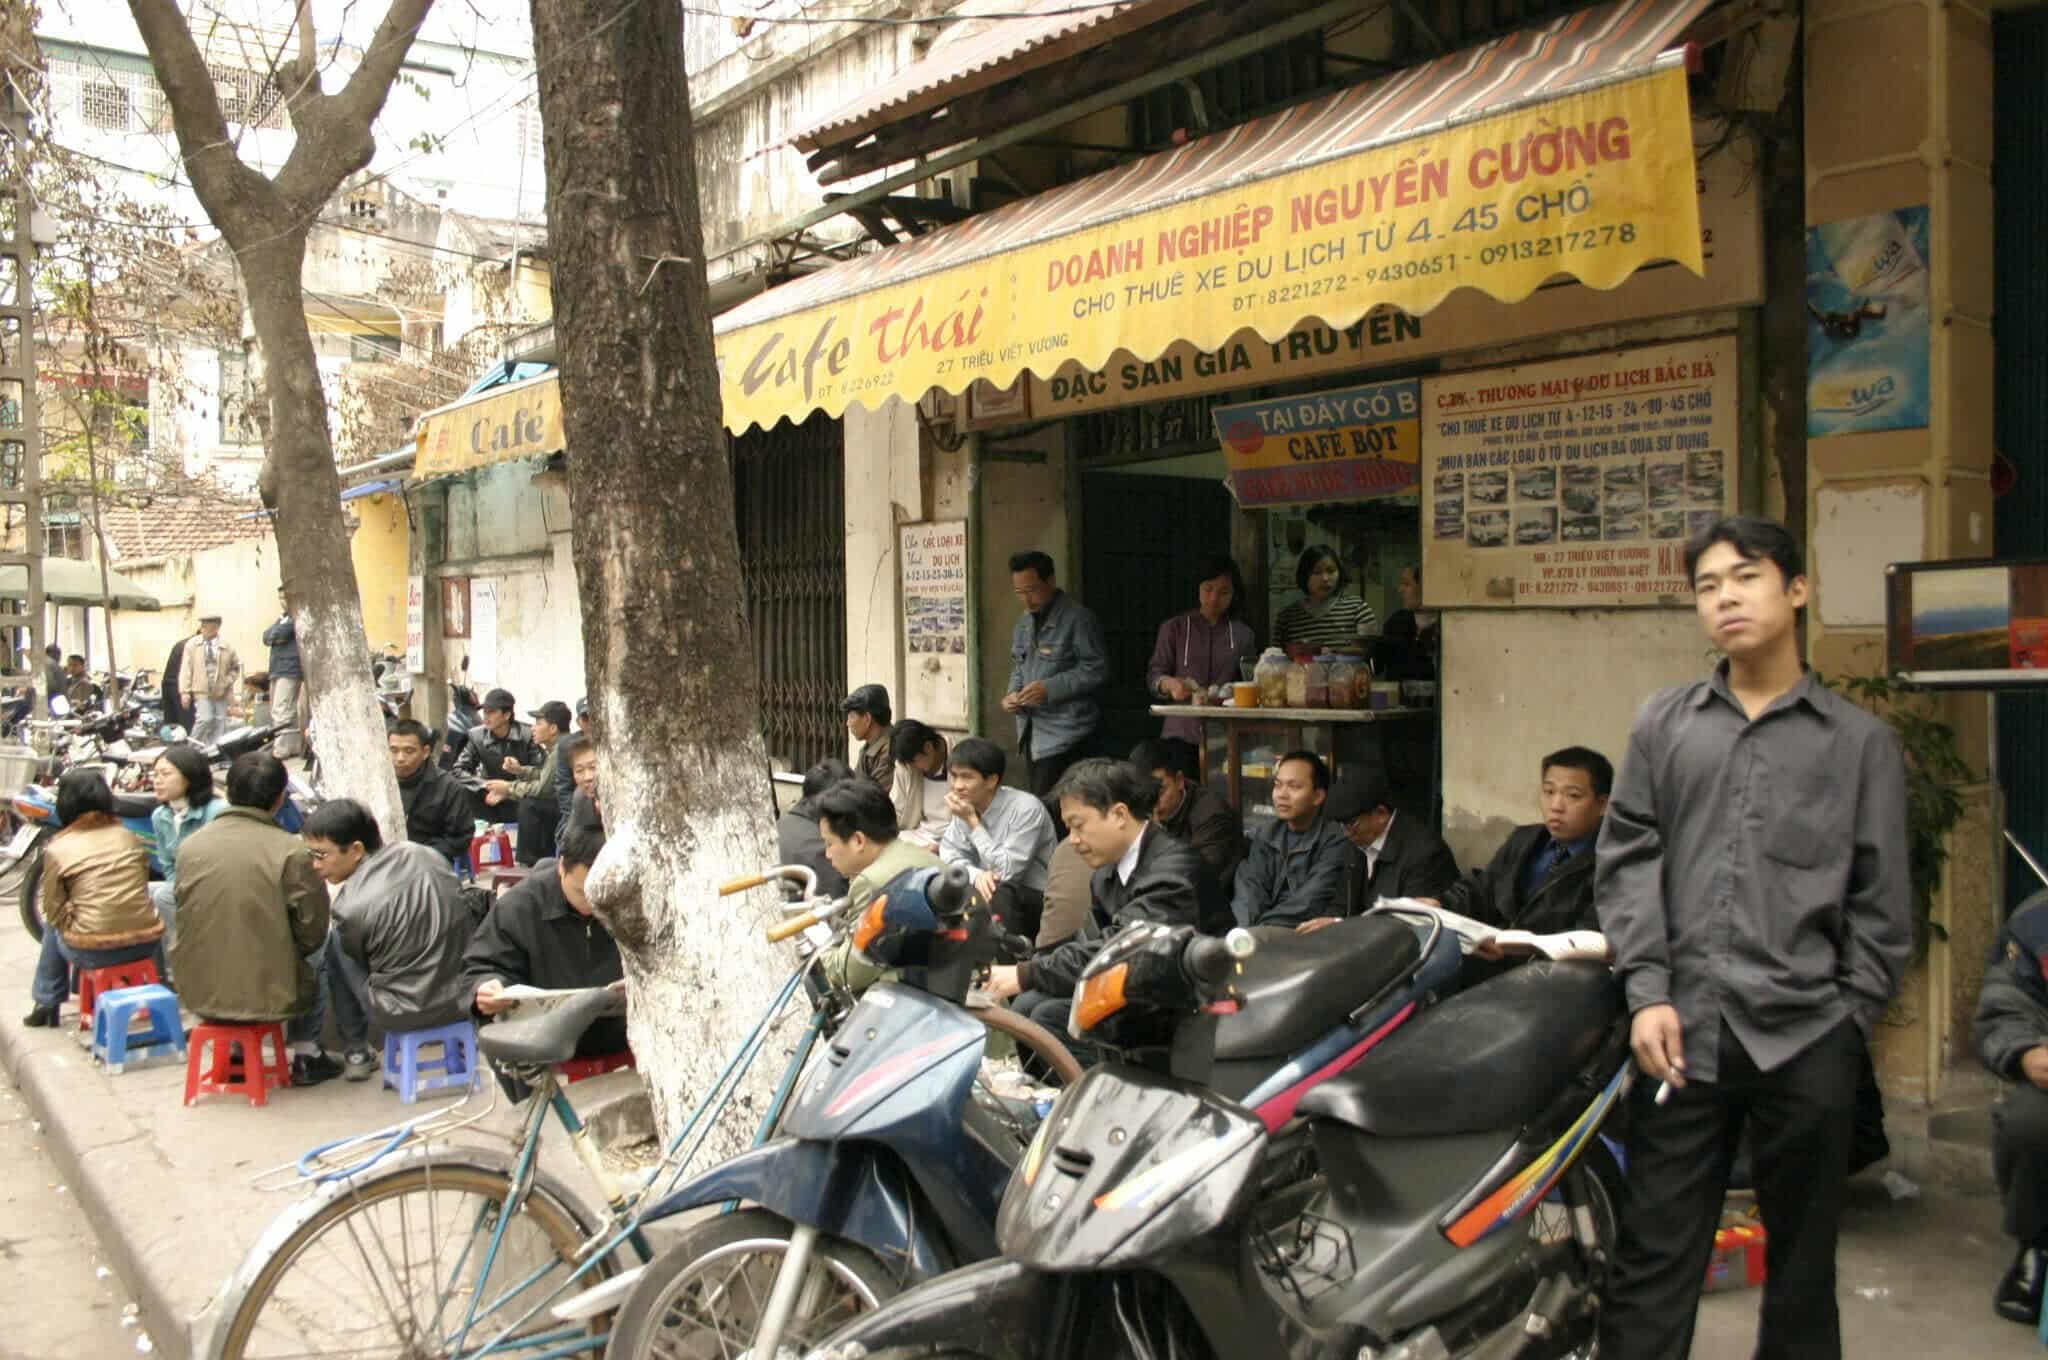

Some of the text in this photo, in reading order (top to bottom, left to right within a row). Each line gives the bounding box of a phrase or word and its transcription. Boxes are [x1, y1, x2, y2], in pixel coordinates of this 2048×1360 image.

[1047, 238, 1144, 292] DOANH
[1157, 203, 1274, 266] NGHIỆP
[1467, 116, 1632, 190] CƯỜNG
[1479, 223, 1637, 266] 0913217278
[1073, 292, 1115, 318] CHO
[1124, 271, 1185, 307] THUÊ
[1196, 265, 1228, 292] XE
[1237, 256, 1273, 283] DU
[1284, 237, 1345, 272] LỊCH
[1357, 219, 1397, 256] TỪ
[869, 286, 989, 364] Thái
[936, 359, 955, 375] 27
[1193, 343, 1253, 377] GIA
[1588, 374, 1610, 391] DU
[1614, 367, 1650, 390] LỊCH
[471, 401, 545, 454] Café
[1255, 404, 1295, 436] TẠI
[1299, 391, 1348, 426] ĐÂY
[1353, 387, 1391, 416] CÓ
[1439, 421, 1461, 437] CHO
[1490, 415, 1504, 431] XE
[1505, 415, 1520, 431] DU
[1566, 443, 1581, 459] DU
[932, 554, 943, 568] DU
